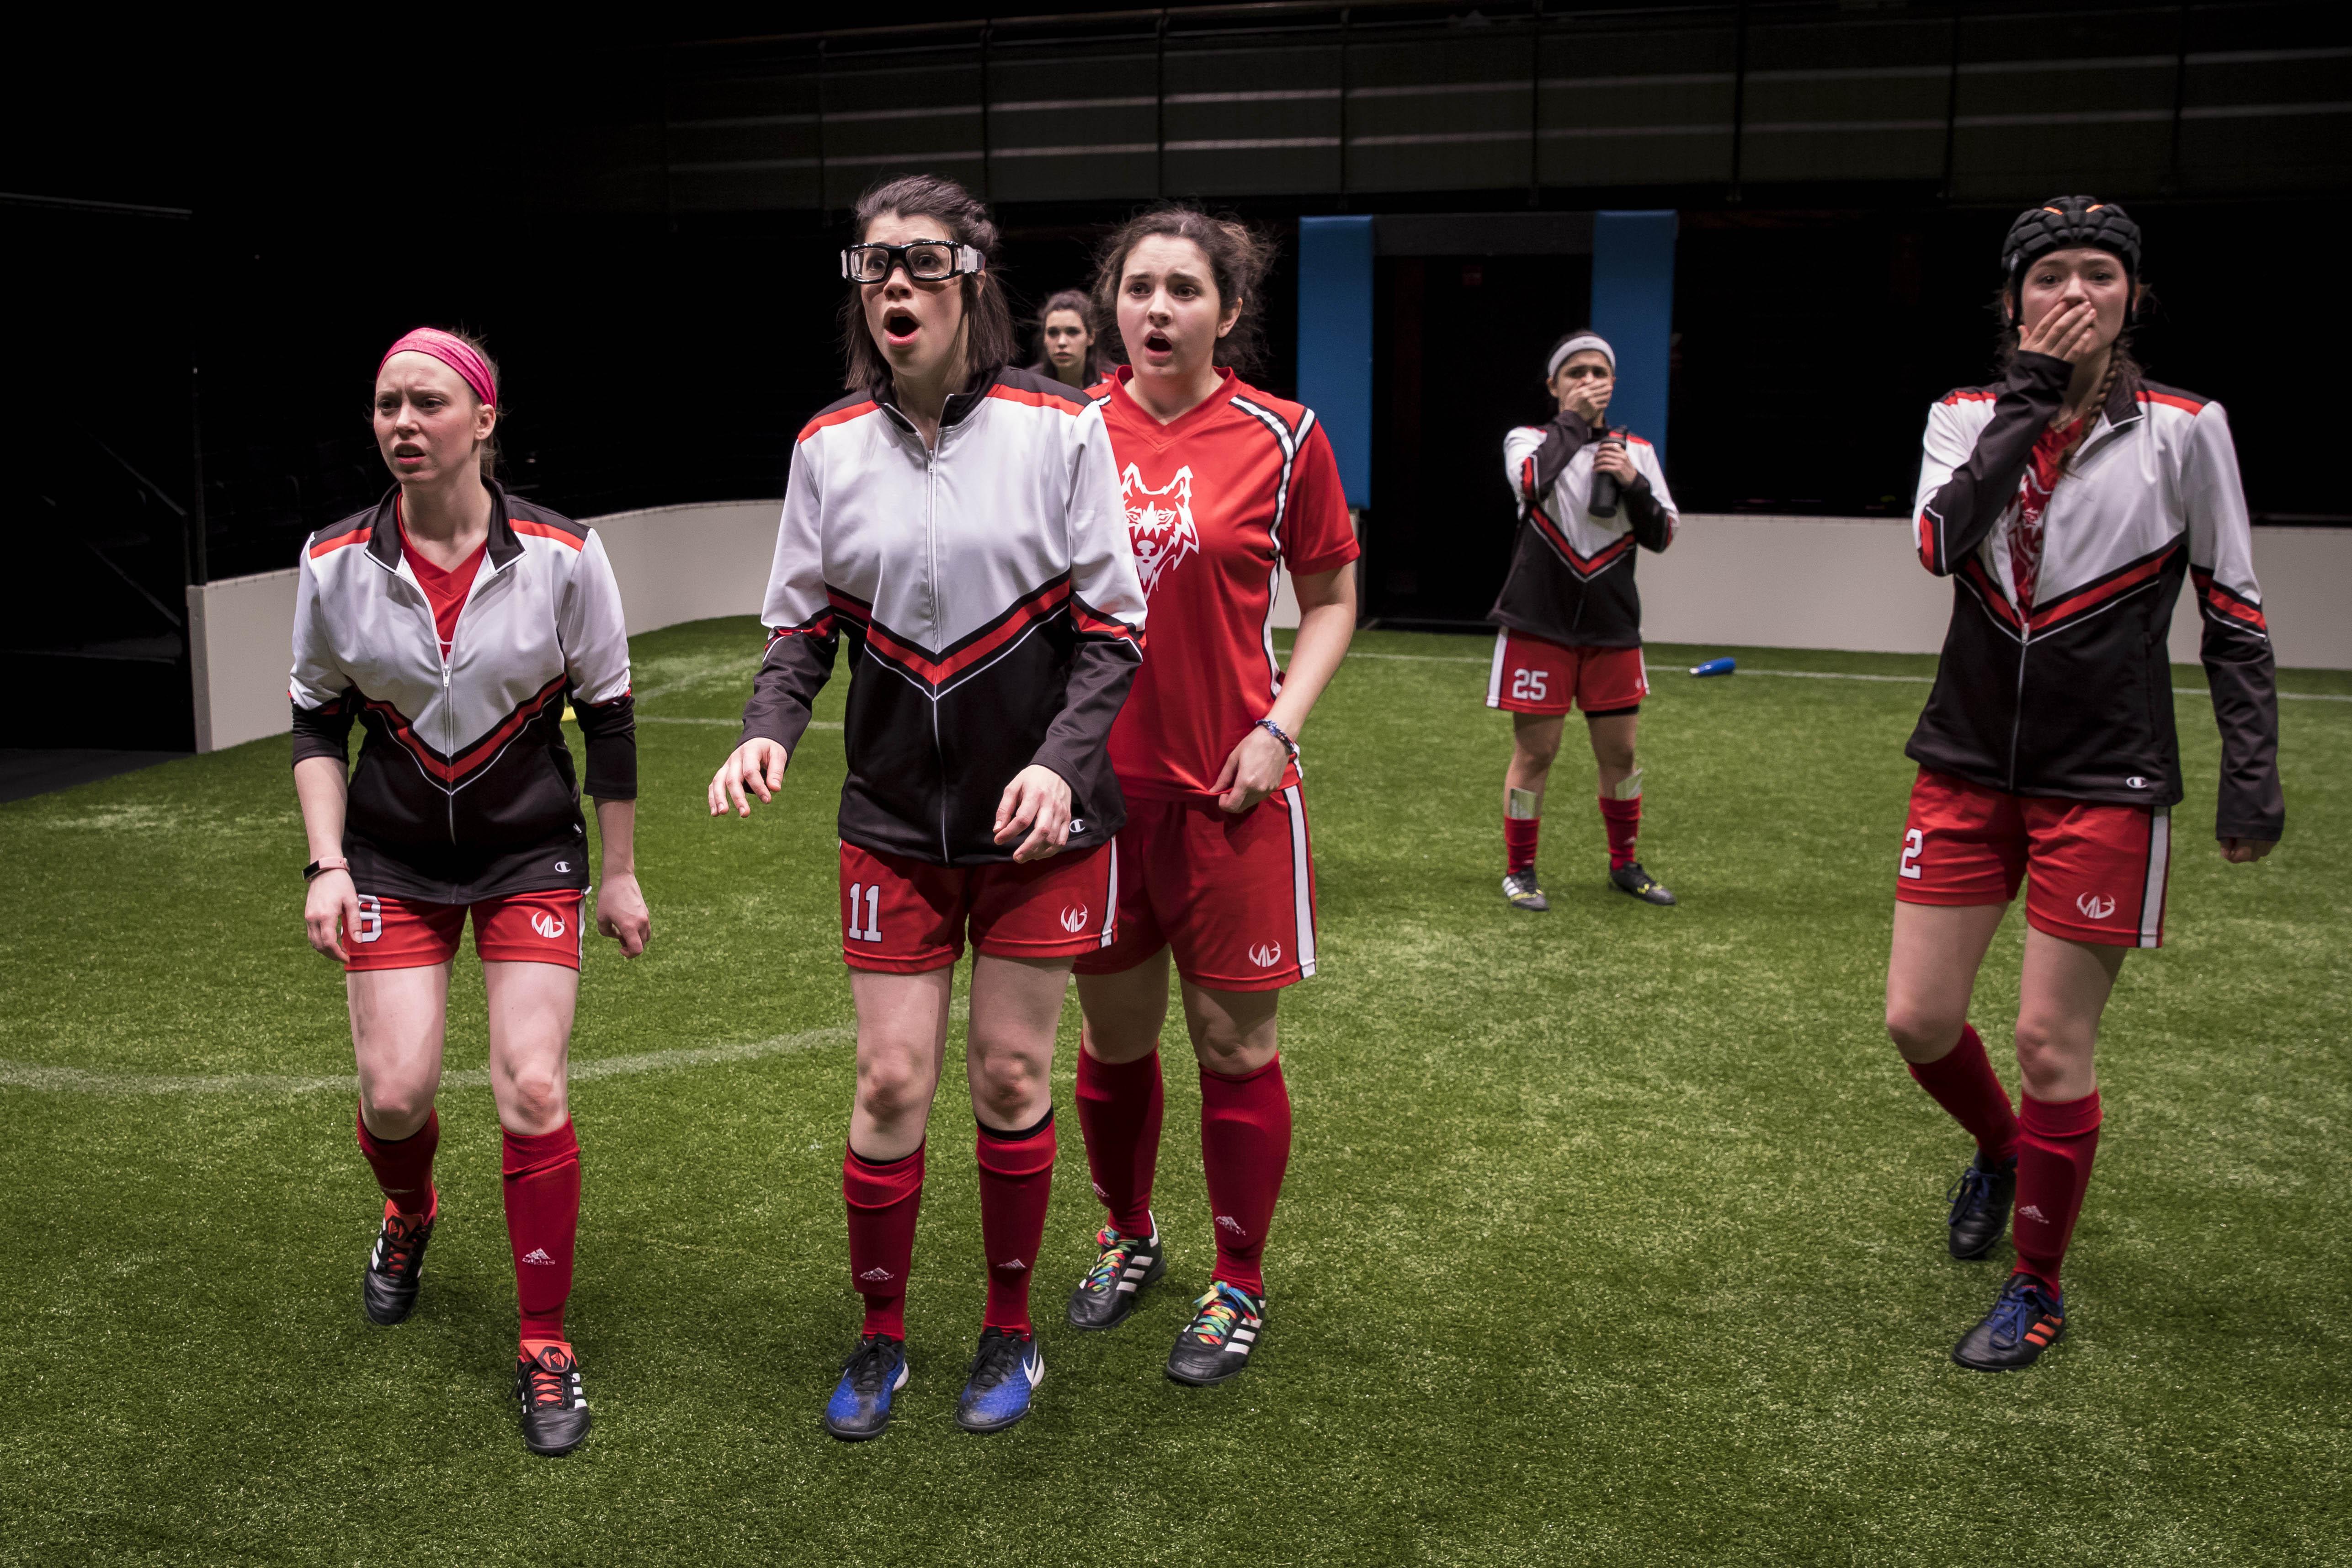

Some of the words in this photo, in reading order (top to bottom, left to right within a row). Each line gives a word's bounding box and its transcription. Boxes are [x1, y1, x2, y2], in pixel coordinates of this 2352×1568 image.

[1512, 668, 1548, 701] 25
[1899, 828, 1923, 879] 2
[849, 882, 882, 942] 11
